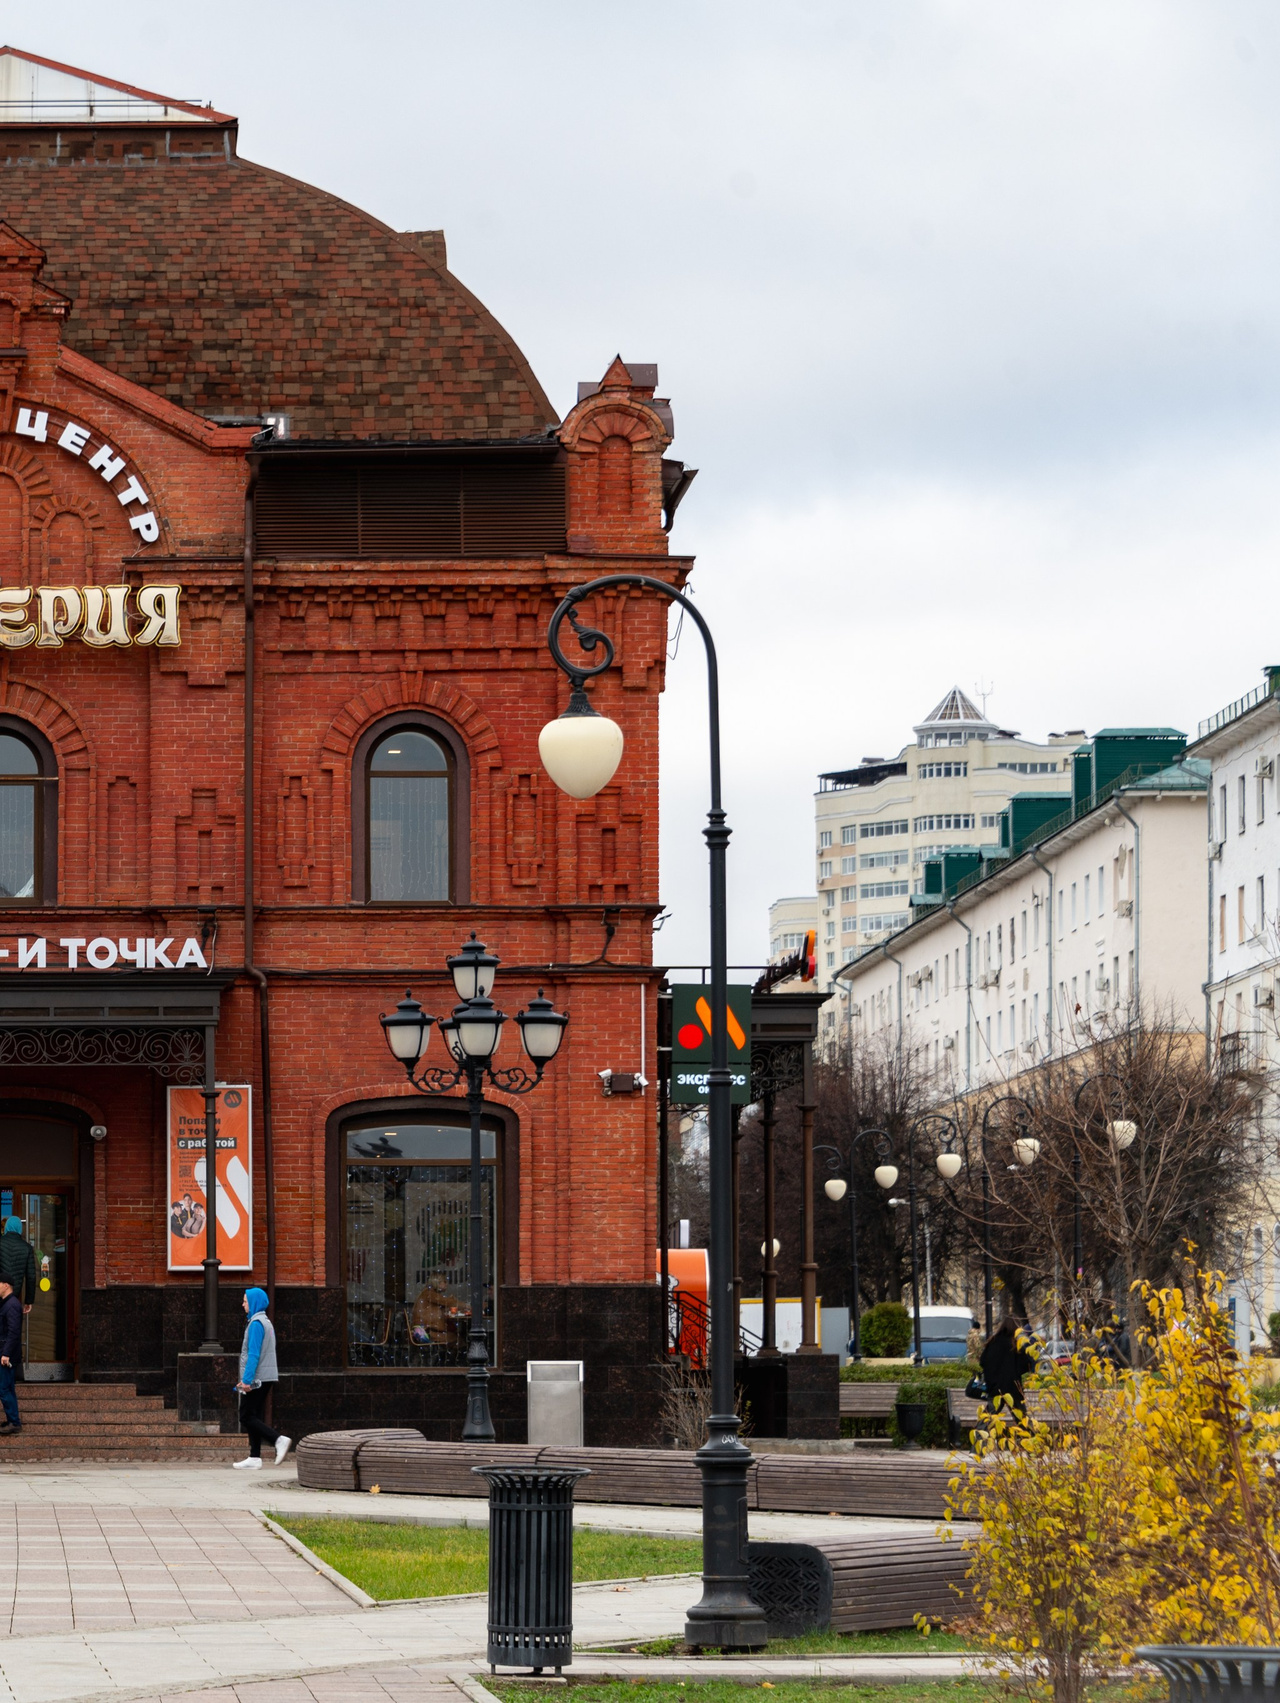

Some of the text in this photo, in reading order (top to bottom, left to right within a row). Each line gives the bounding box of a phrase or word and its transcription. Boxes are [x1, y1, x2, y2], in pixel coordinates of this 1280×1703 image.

[15, 407, 160, 543] ЦЕНТР
[18, 937, 47, 968] И
[67, 937, 208, 969] ТОЧКА
[677, 1073, 746, 1086] ЭКСПСС
[179, 1116, 221, 1125] Попаи
[188, 1129, 220, 1137] точу
[188, 1137, 235, 1149] рабтой
